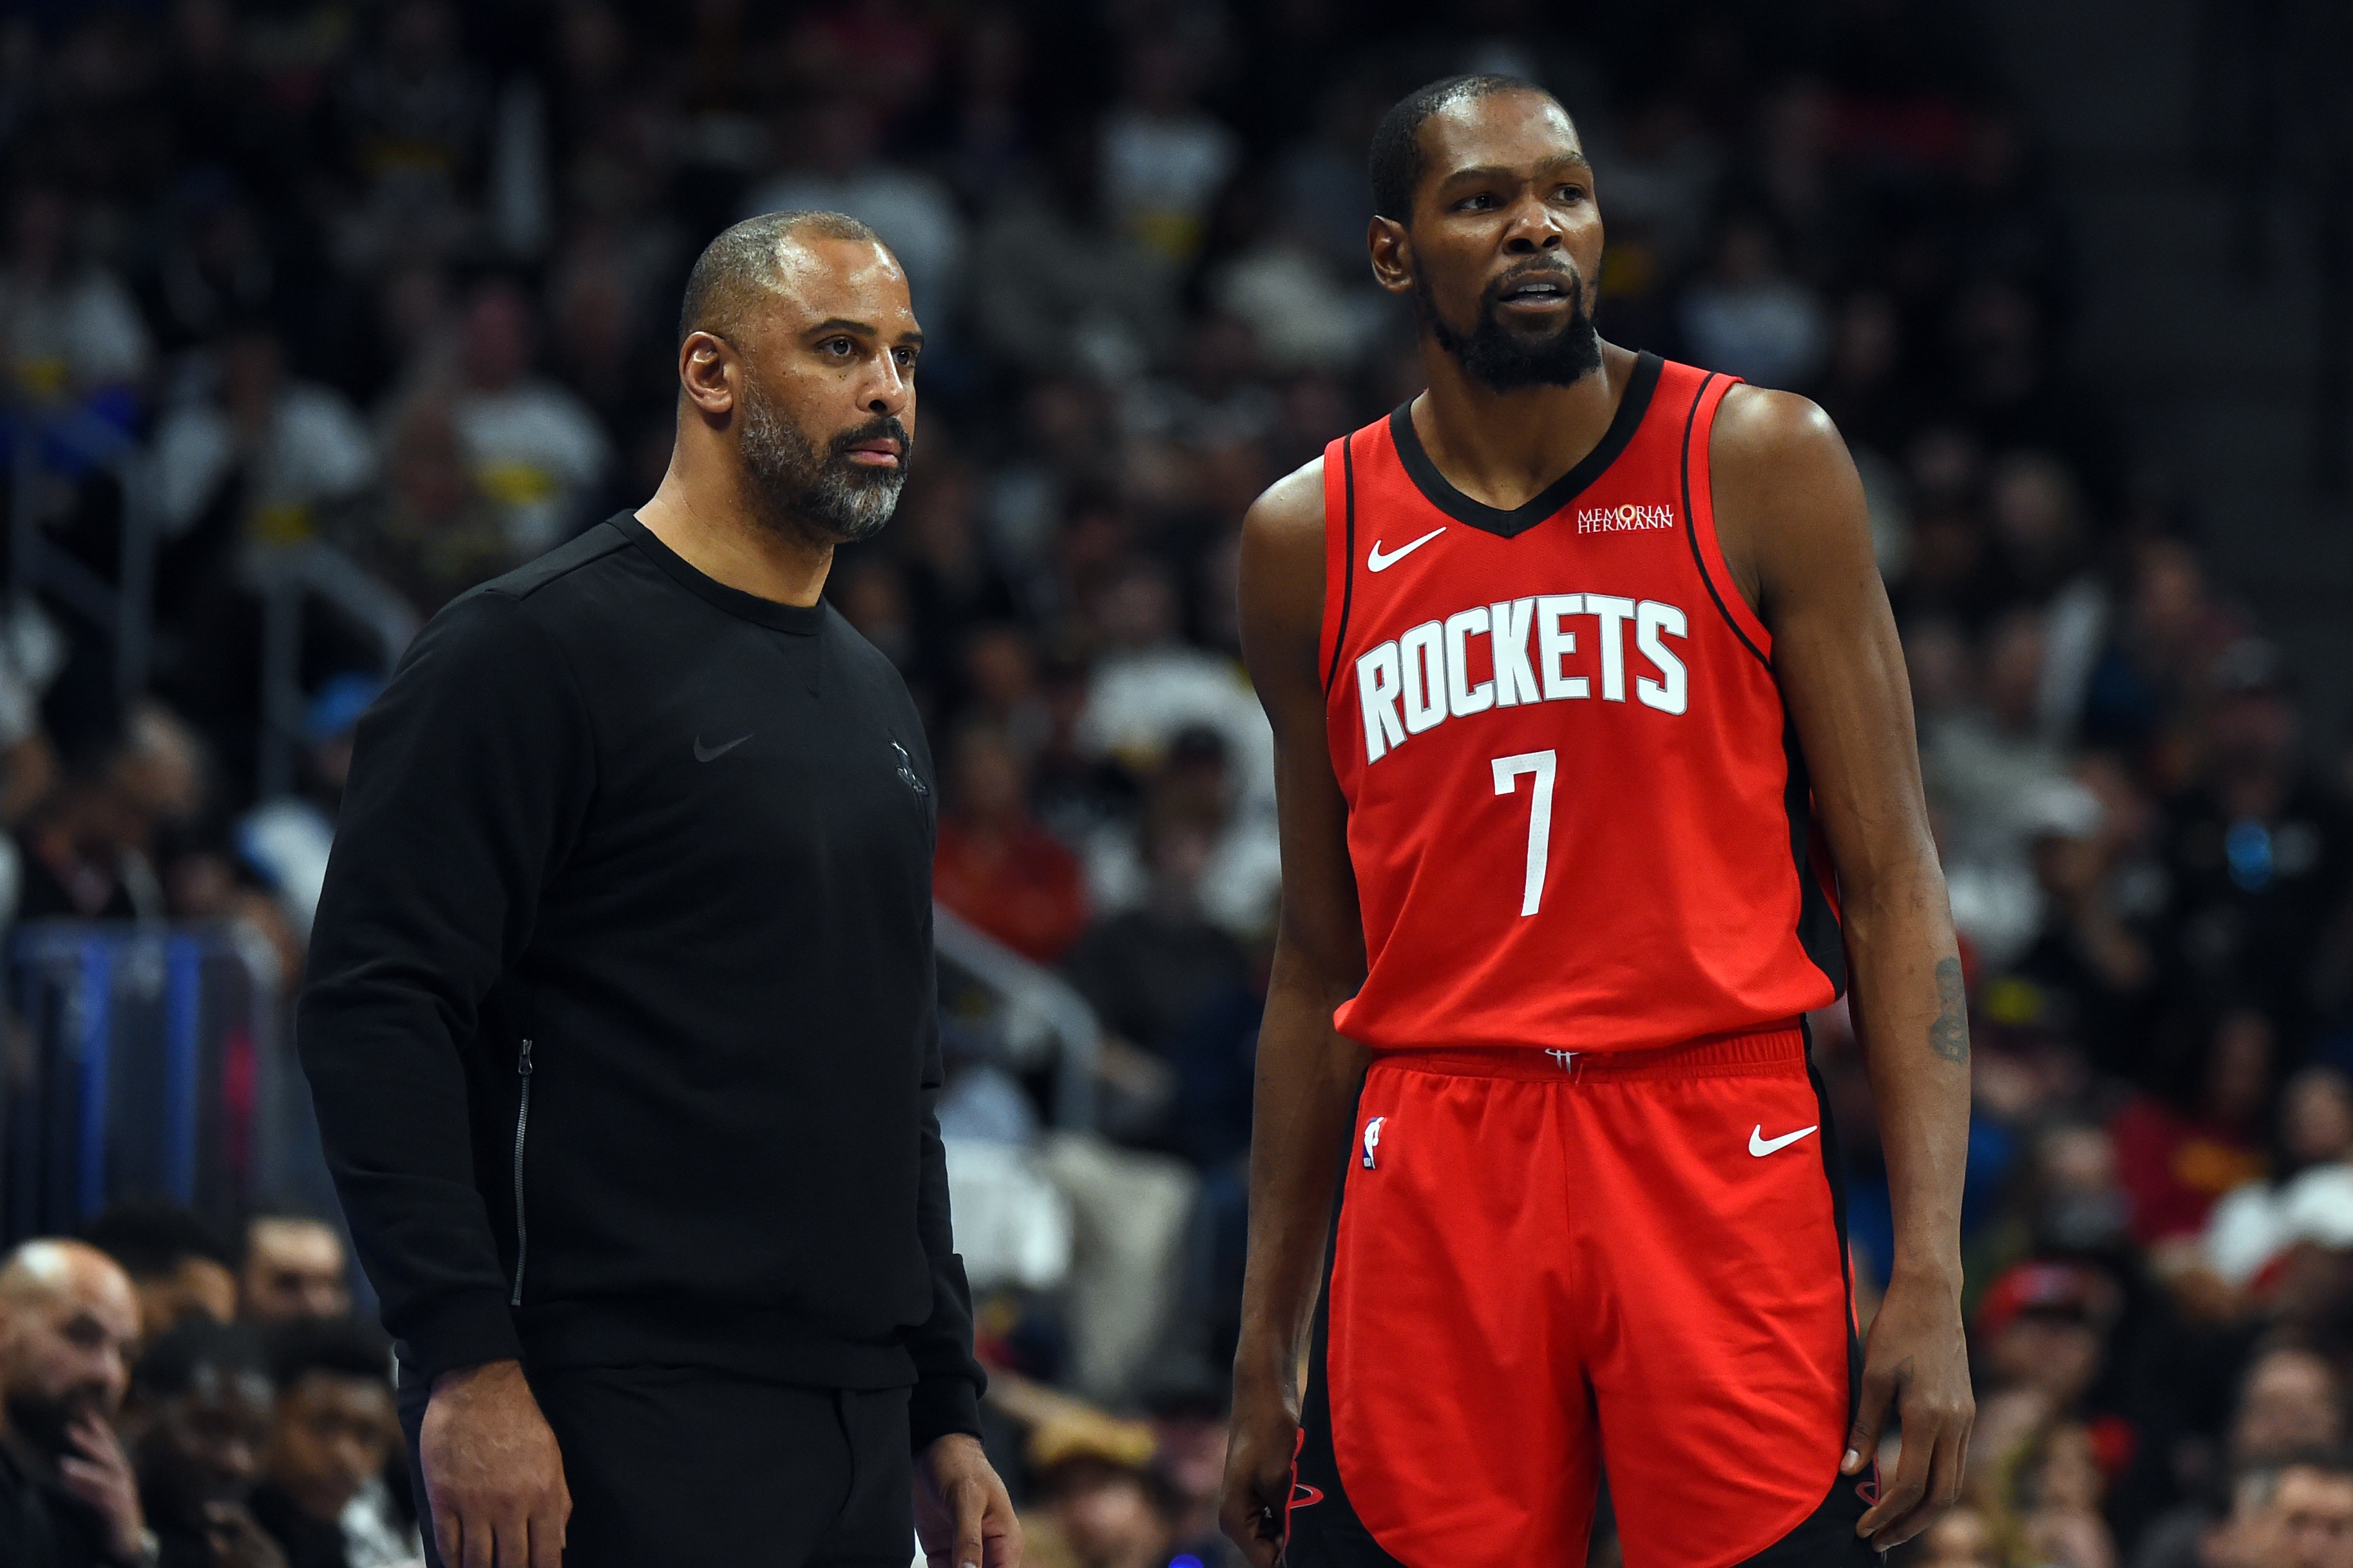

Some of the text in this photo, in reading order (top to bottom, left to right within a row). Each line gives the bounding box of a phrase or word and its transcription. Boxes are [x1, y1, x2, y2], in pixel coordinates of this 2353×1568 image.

[1577, 516, 1673, 534] HERMANN
[1578, 504, 1674, 522] MEMORIAL
[1355, 592, 1688, 765] ROCKETS
[1491, 749, 1557, 917] 7
